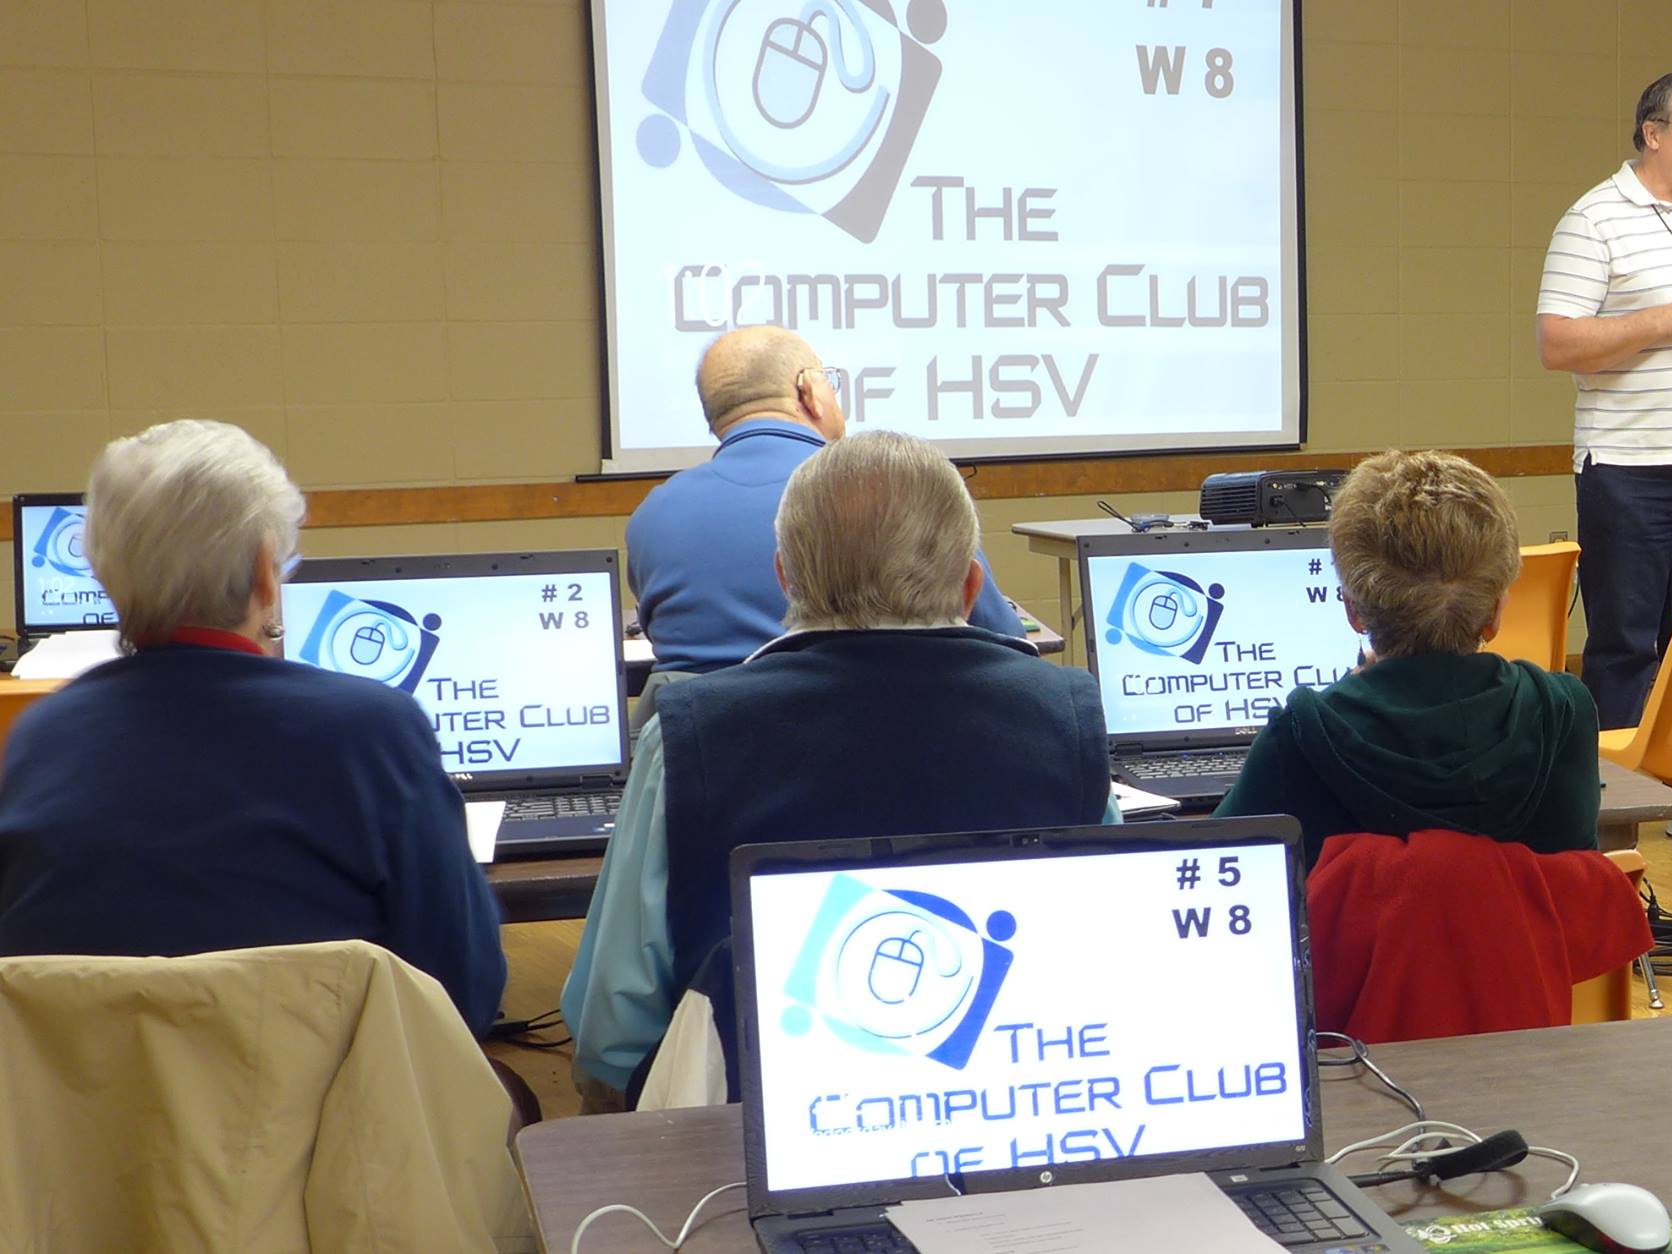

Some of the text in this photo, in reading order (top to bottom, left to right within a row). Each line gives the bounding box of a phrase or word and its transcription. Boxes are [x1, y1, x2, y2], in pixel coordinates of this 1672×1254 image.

[1136, 44, 1234, 98] W 8
[910, 175, 1059, 242] THE
[674, 263, 1270, 332] COMPUTER CLUB
[927, 352, 1099, 421] HSV
[1308, 558, 1322, 575] #
[542, 583, 583, 602] # 2
[1306, 586, 1327, 603] W
[538, 610, 589, 630] W 8
[1214, 641, 1276, 662] THE
[427, 677, 499, 701] THE
[1122, 670, 1283, 696] COMPUTER
[519, 704, 610, 728] CLUB
[1174, 703, 1213, 724] OF
[1176, 856, 1241, 890] # 5
[1171, 904, 1252, 939] W 8
[993, 1022, 1110, 1064] THE
[809, 1062, 1287, 1136] COMPUTER CLUB
